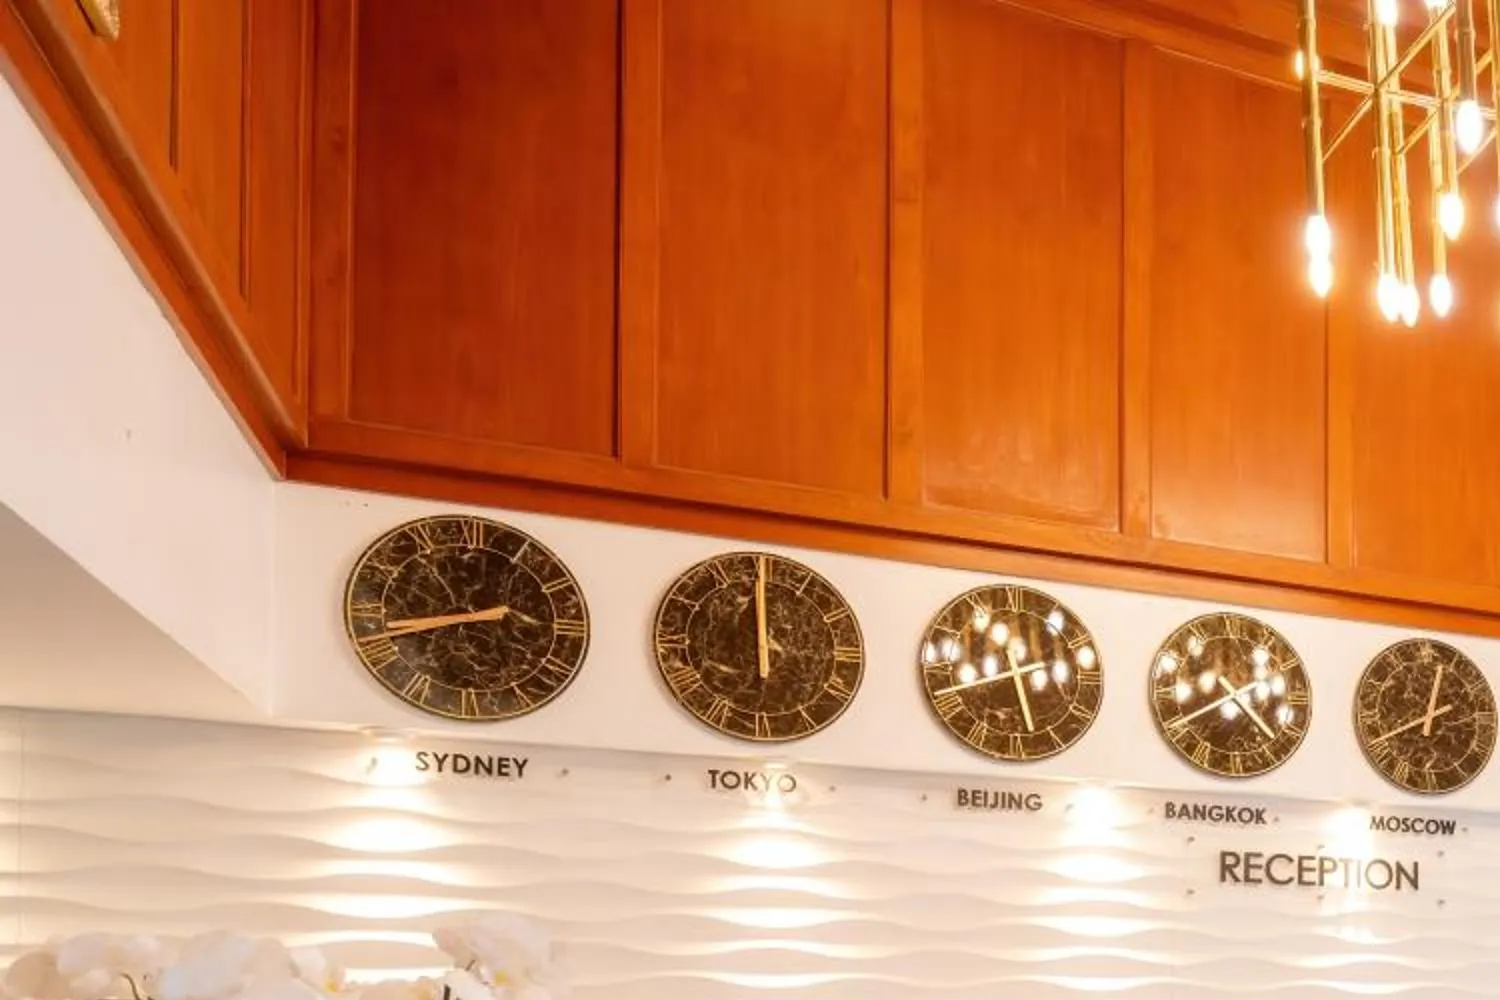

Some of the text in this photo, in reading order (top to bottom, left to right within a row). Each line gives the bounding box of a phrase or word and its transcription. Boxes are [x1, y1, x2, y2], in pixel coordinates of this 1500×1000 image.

[416, 751, 529, 779] SYDNEY
[707, 769, 797, 793] TOKYO
[957, 788, 1043, 812] BEIJING
[1164, 801, 1267, 825] BANGKOK
[1370, 815, 1456, 835] MOSCOW
[1219, 849, 1420, 892] RECEPTION
